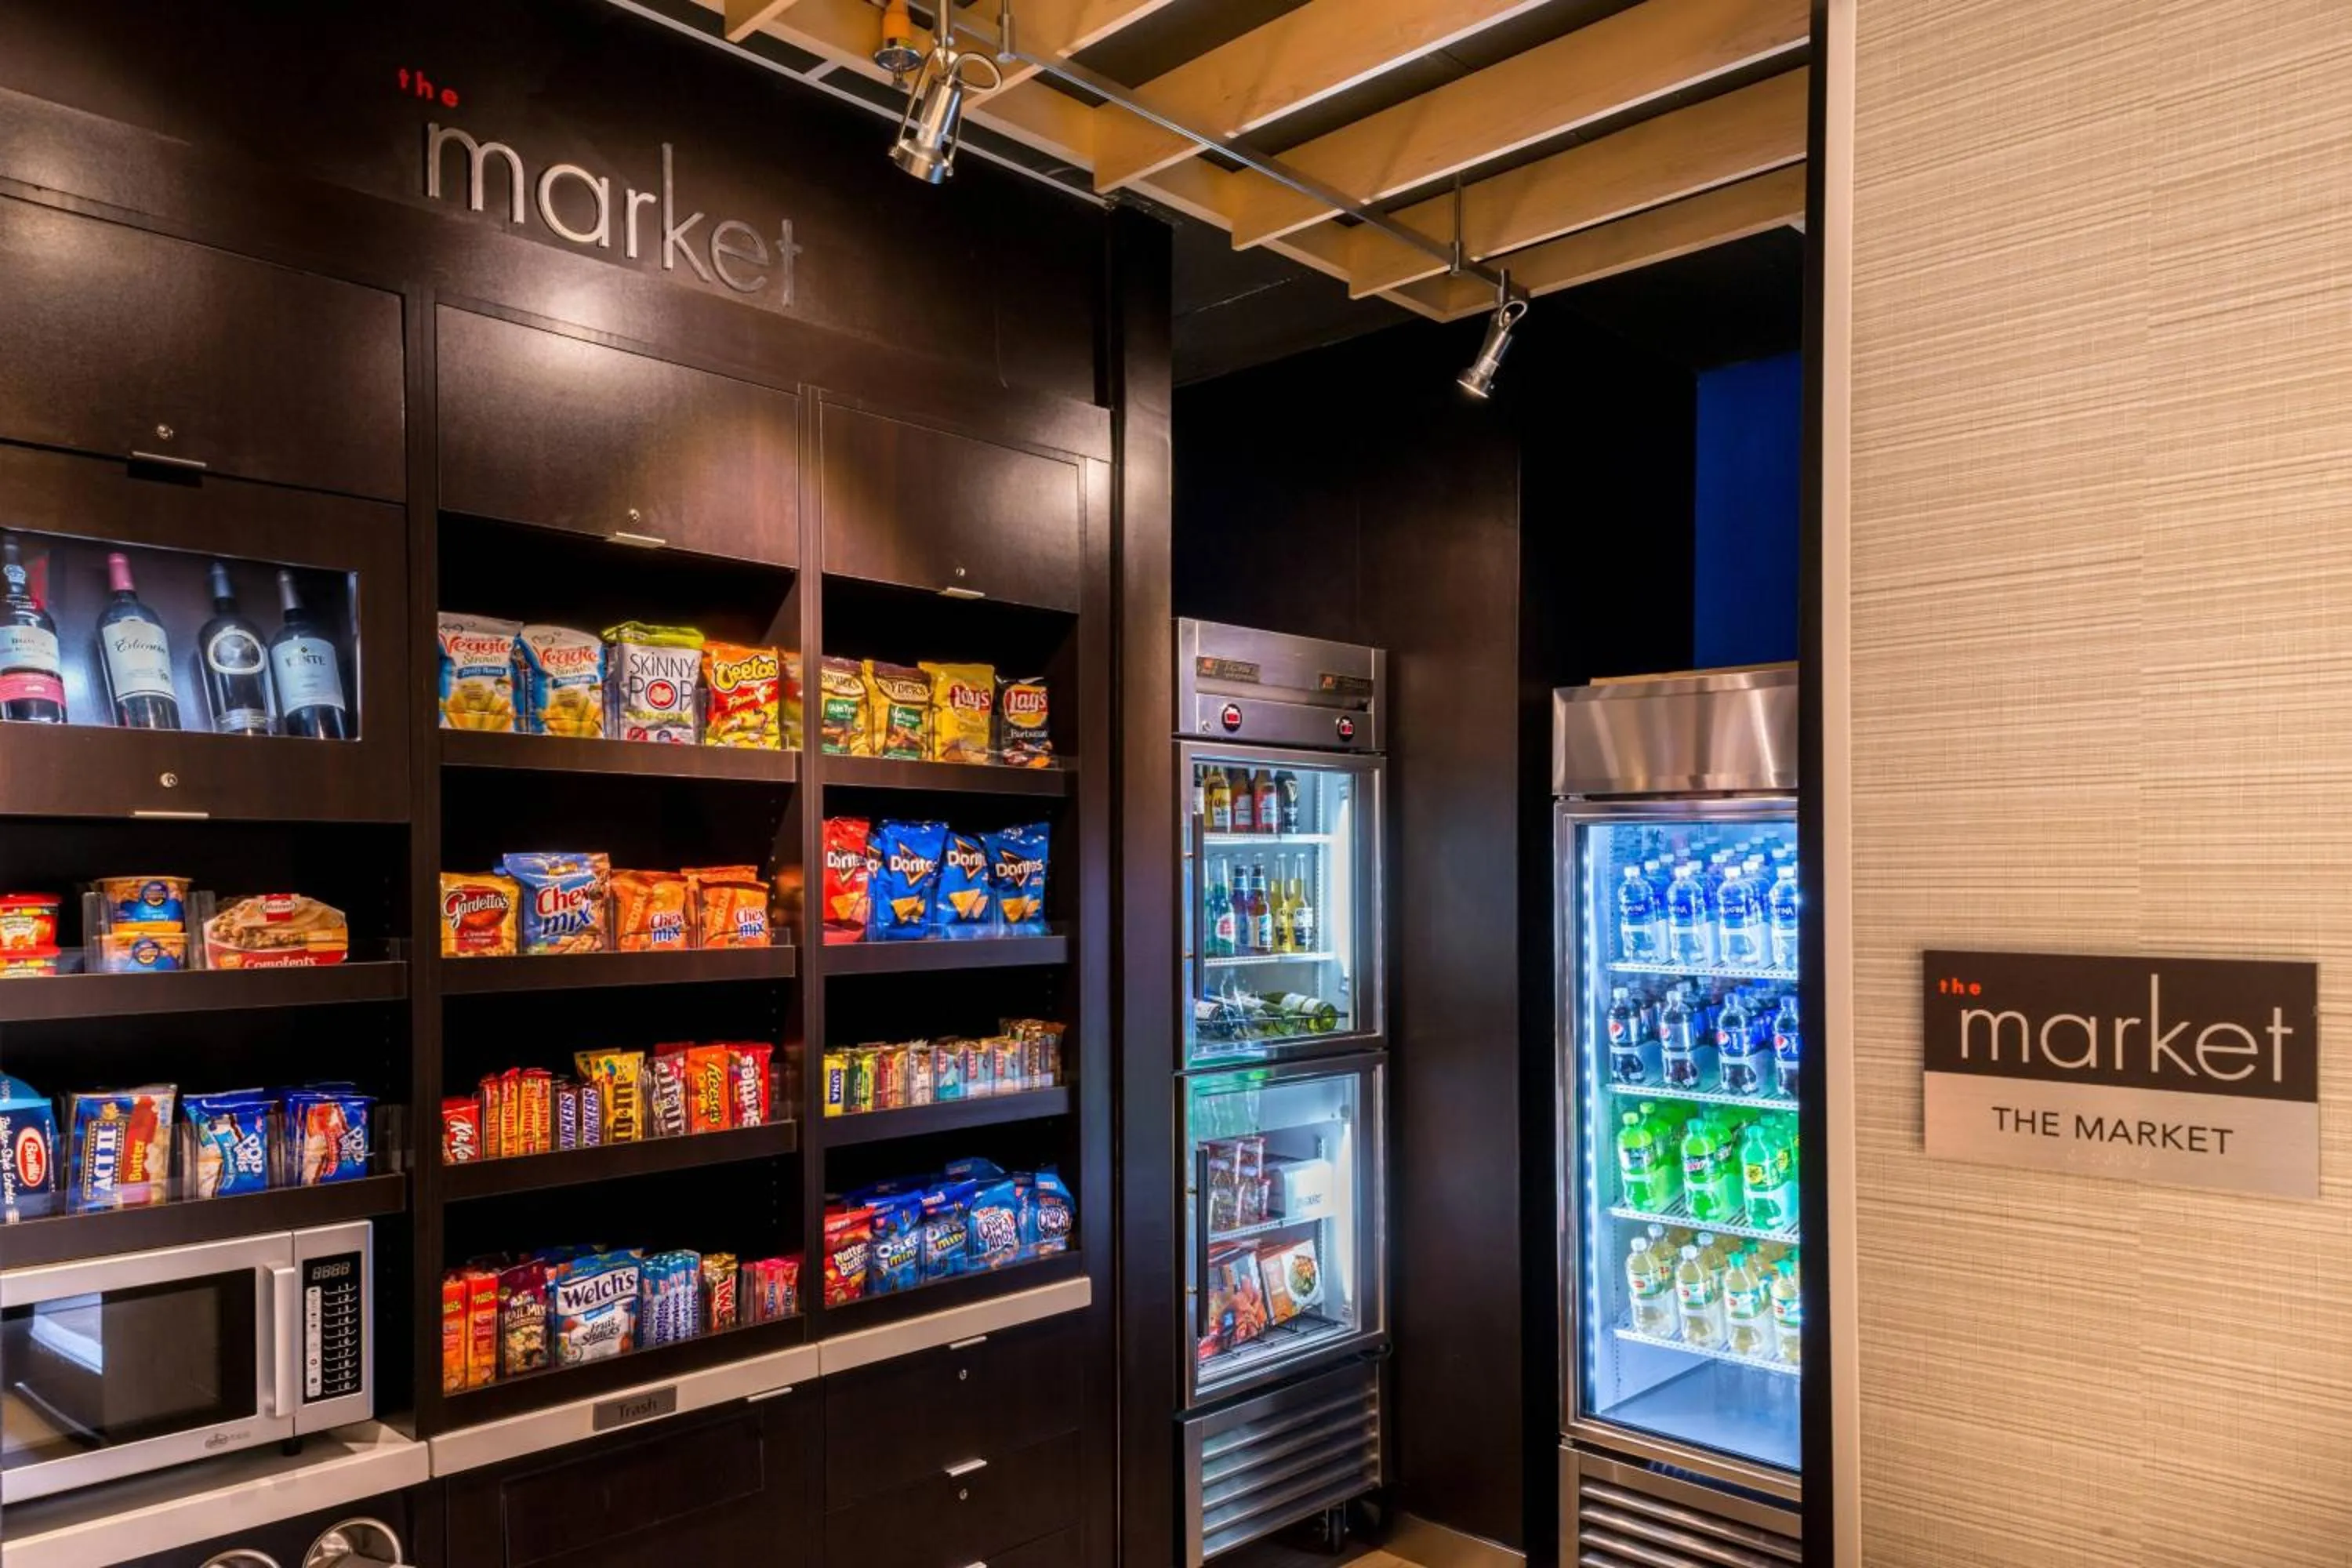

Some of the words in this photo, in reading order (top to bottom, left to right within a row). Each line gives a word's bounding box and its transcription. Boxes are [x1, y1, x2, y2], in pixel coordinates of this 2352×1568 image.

[399, 68, 459, 108] the
[427, 122, 803, 307] market
[439, 633, 511, 654] Veggie
[629, 652, 695, 678] SKINNY
[629, 677, 693, 711] POP
[954, 686, 989, 710] Lay's
[1009, 691, 1047, 714] Lay's
[995, 858, 1044, 877] Doritos
[443, 890, 509, 929] Gardetto's
[536, 882, 593, 916] Chex
[735, 908, 765, 924] Chex
[540, 899, 594, 938] mix
[650, 911, 683, 928] Chex
[1940, 978, 1982, 996] the
[1961, 973, 2293, 1083] market
[706, 1062, 722, 1124] Reese's
[561, 1093, 575, 1149] NICKERS
[583, 1087, 599, 1147] NICKERS
[1991, 1106, 2060, 1137] THE
[2074, 1113, 2234, 1155] MARKET
[24, 1142, 42, 1181] Barilla
[93, 1152, 115, 1191] ACT
[128, 1139, 146, 1181] Butter
[562, 1271, 634, 1309] Welch's
[617, 1398, 658, 1419] Trash
